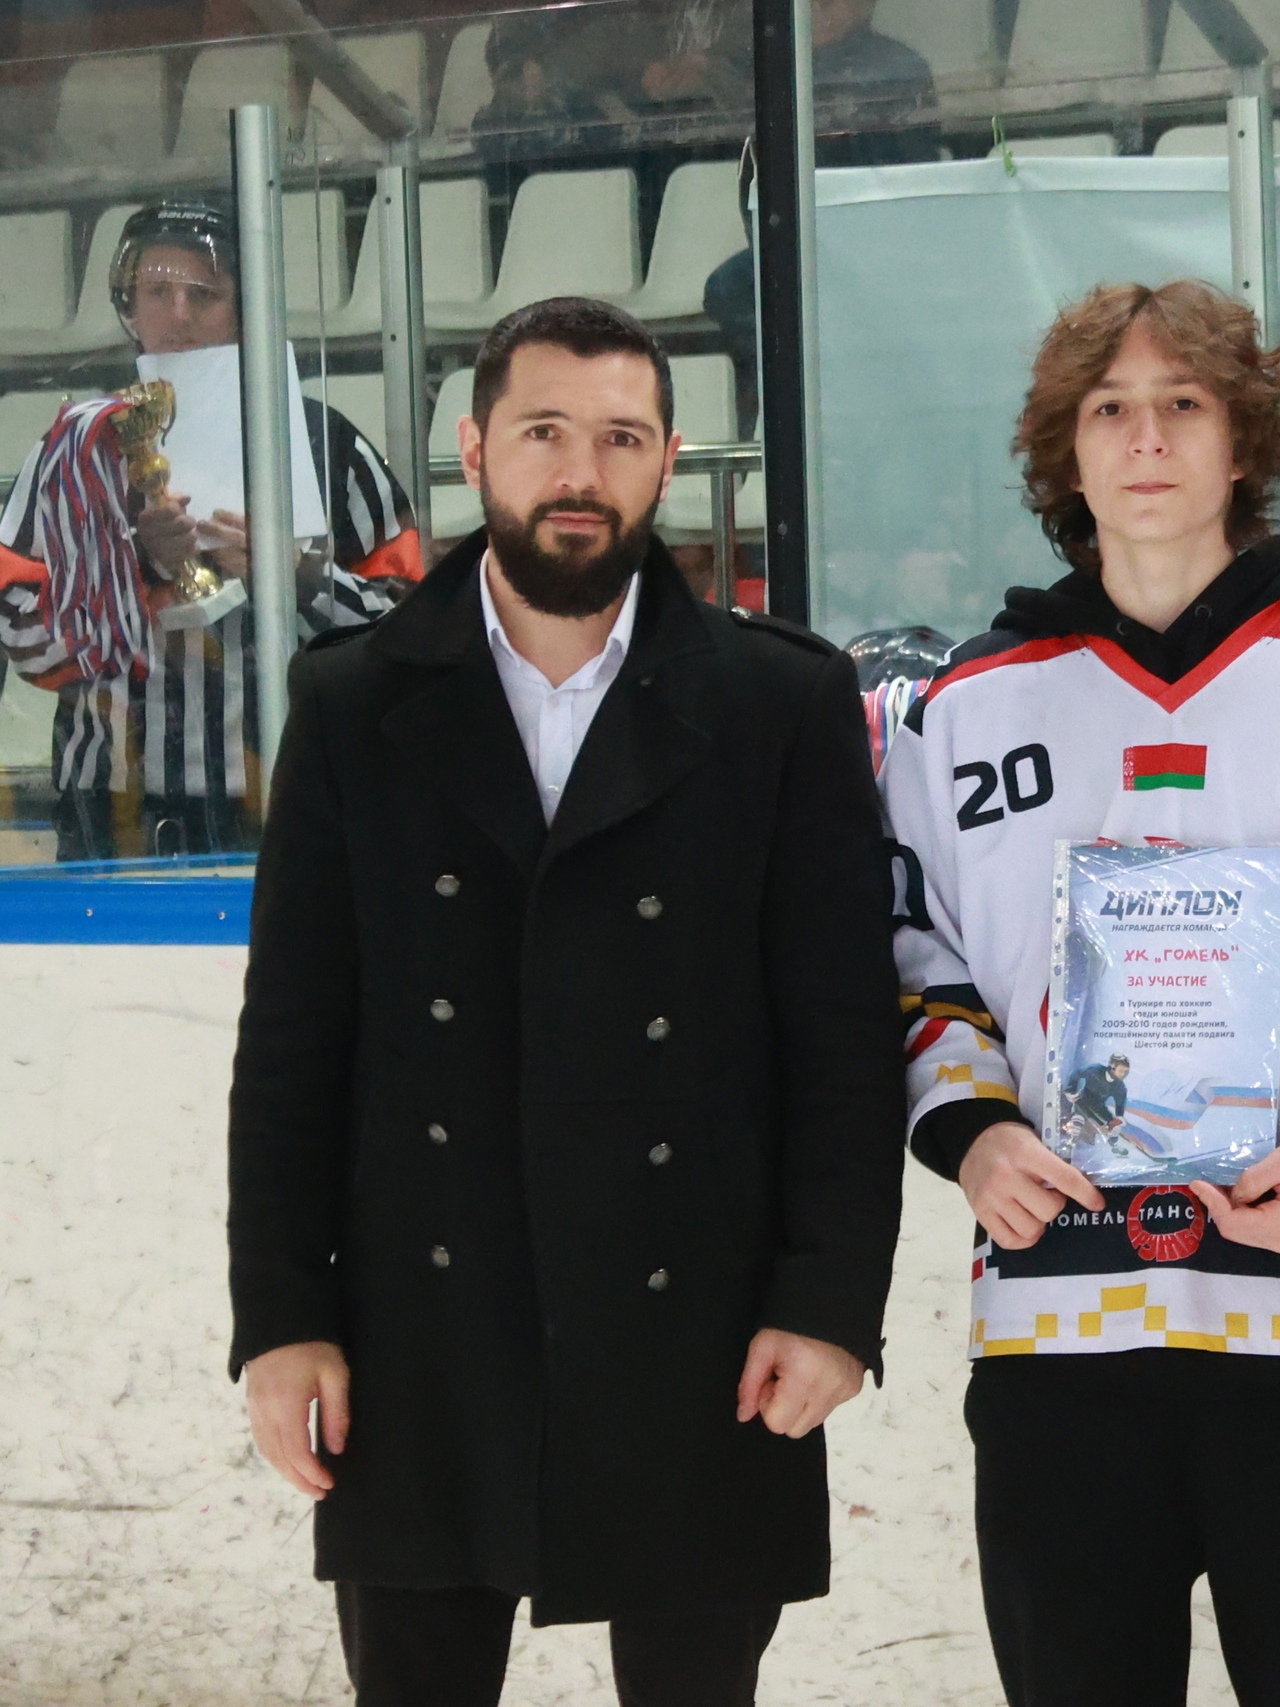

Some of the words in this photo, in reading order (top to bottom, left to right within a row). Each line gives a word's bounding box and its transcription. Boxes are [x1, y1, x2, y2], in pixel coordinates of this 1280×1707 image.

[953, 743, 1053, 832] 20
[1100, 890, 1242, 921] ДИПЛОМ
[1112, 924, 1181, 932] НАГРАЖДАЕТСЯ
[1124, 949, 1149, 962] ХК
[1127, 976, 1143, 987] ЗА
[1149, 975, 1207, 987] УЧАСТИЕ
[1127, 1000, 1164, 1009] Турнире
[1102, 1020, 1150, 1028] 2009-2010
[1152, 1021, 1177, 1029] годов
[1180, 1021, 1228, 1029] рождения,
[1198, 1031, 1235, 1039] подвига
[1139, 1205, 1195, 1221] ТРАНС
